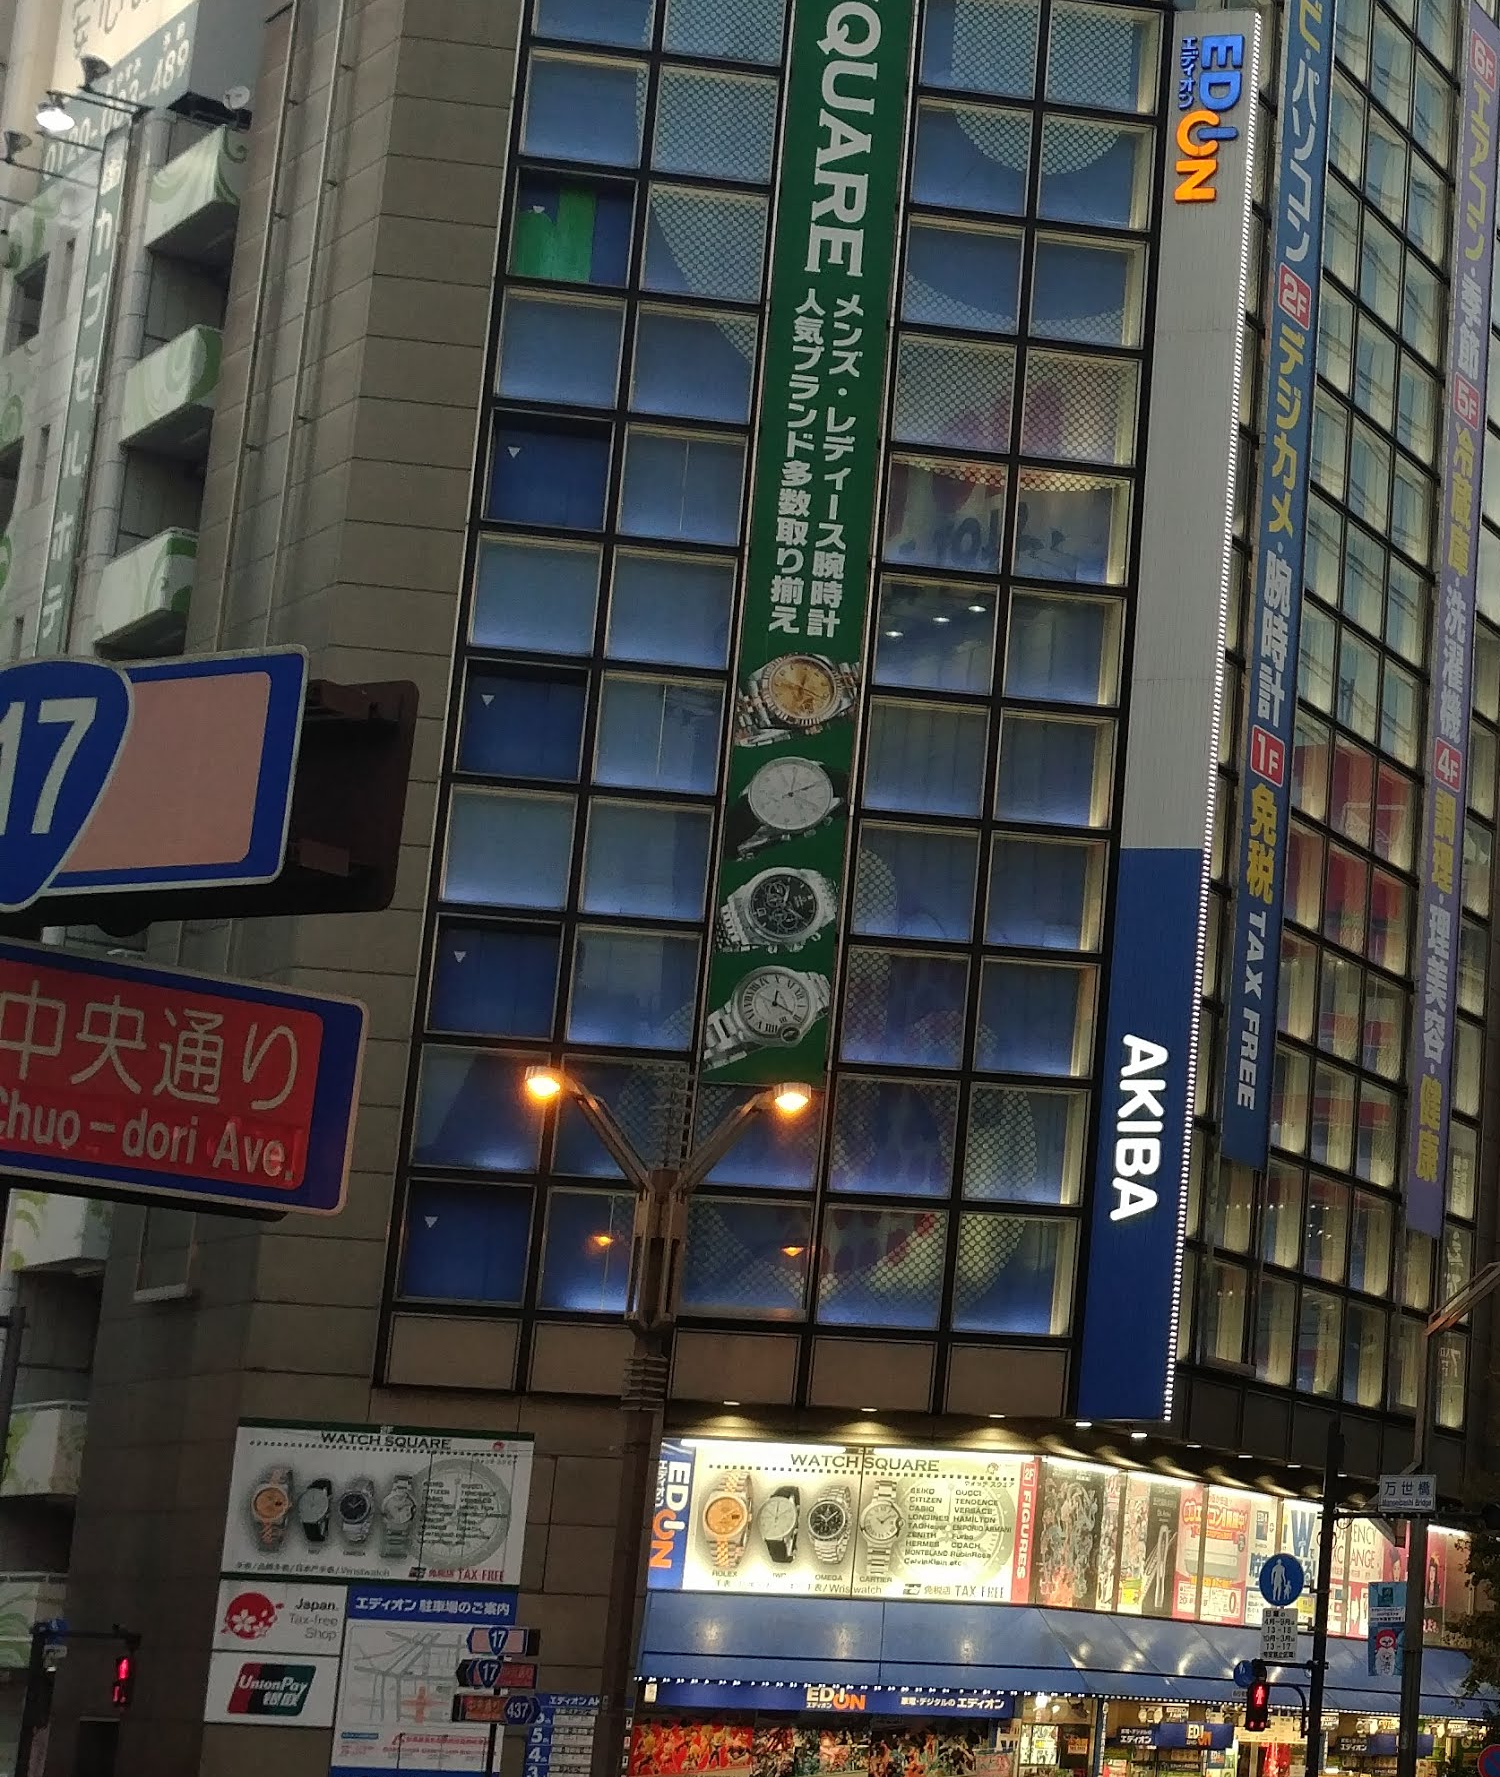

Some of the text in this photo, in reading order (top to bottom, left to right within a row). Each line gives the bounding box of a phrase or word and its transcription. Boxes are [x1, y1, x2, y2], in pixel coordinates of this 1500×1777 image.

[1178, 36, 1200, 111] エディオン
[1280, 264, 1310, 329] 2F
[768, 287, 826, 635] 人気ブランド多数取り揃え
[807, 293, 865, 639] メンズ・レディース腕時計
[1247, 787, 1279, 908] 免税
[1237, 911, 1267, 1112] TAX FREE
[0, 979, 298, 1112] 中央通り
[1109, 1032, 1169, 1222] AKIBA
[211, 1118, 295, 1182] Ave.
[320, 1431, 452, 1450] WATCH SQUARE
[790, 1453, 940, 1472] WATCH SQUARE
[909, 1487, 935, 1495] SEIKO
[1384, 1481, 1431, 1496] 万世橋
[908, 1496, 943, 1504] CITIZEN
[953, 1515, 996, 1524] HAMILTON
[906, 1531, 937, 1539] ZENITH
[1016, 1491, 1032, 1579] FIGURES
[905, 1540, 940, 1548] HERMES
[951, 1541, 981, 1549] COACH
[457, 1568, 505, 1583] TAX FREE
[955, 1584, 976, 1596] TAX
[355, 1596, 417, 1611] エディオン
[305, 1627, 337, 1641] Shop
[492, 1630, 505, 1648] 17
[483, 1664, 498, 1681] 17
[238, 1674, 308, 1695] UnionPay
[506, 1702, 529, 1719] 437
[956, 1697, 1005, 1710] エディオン
[1119, 1735, 1153, 1745] エディオン
